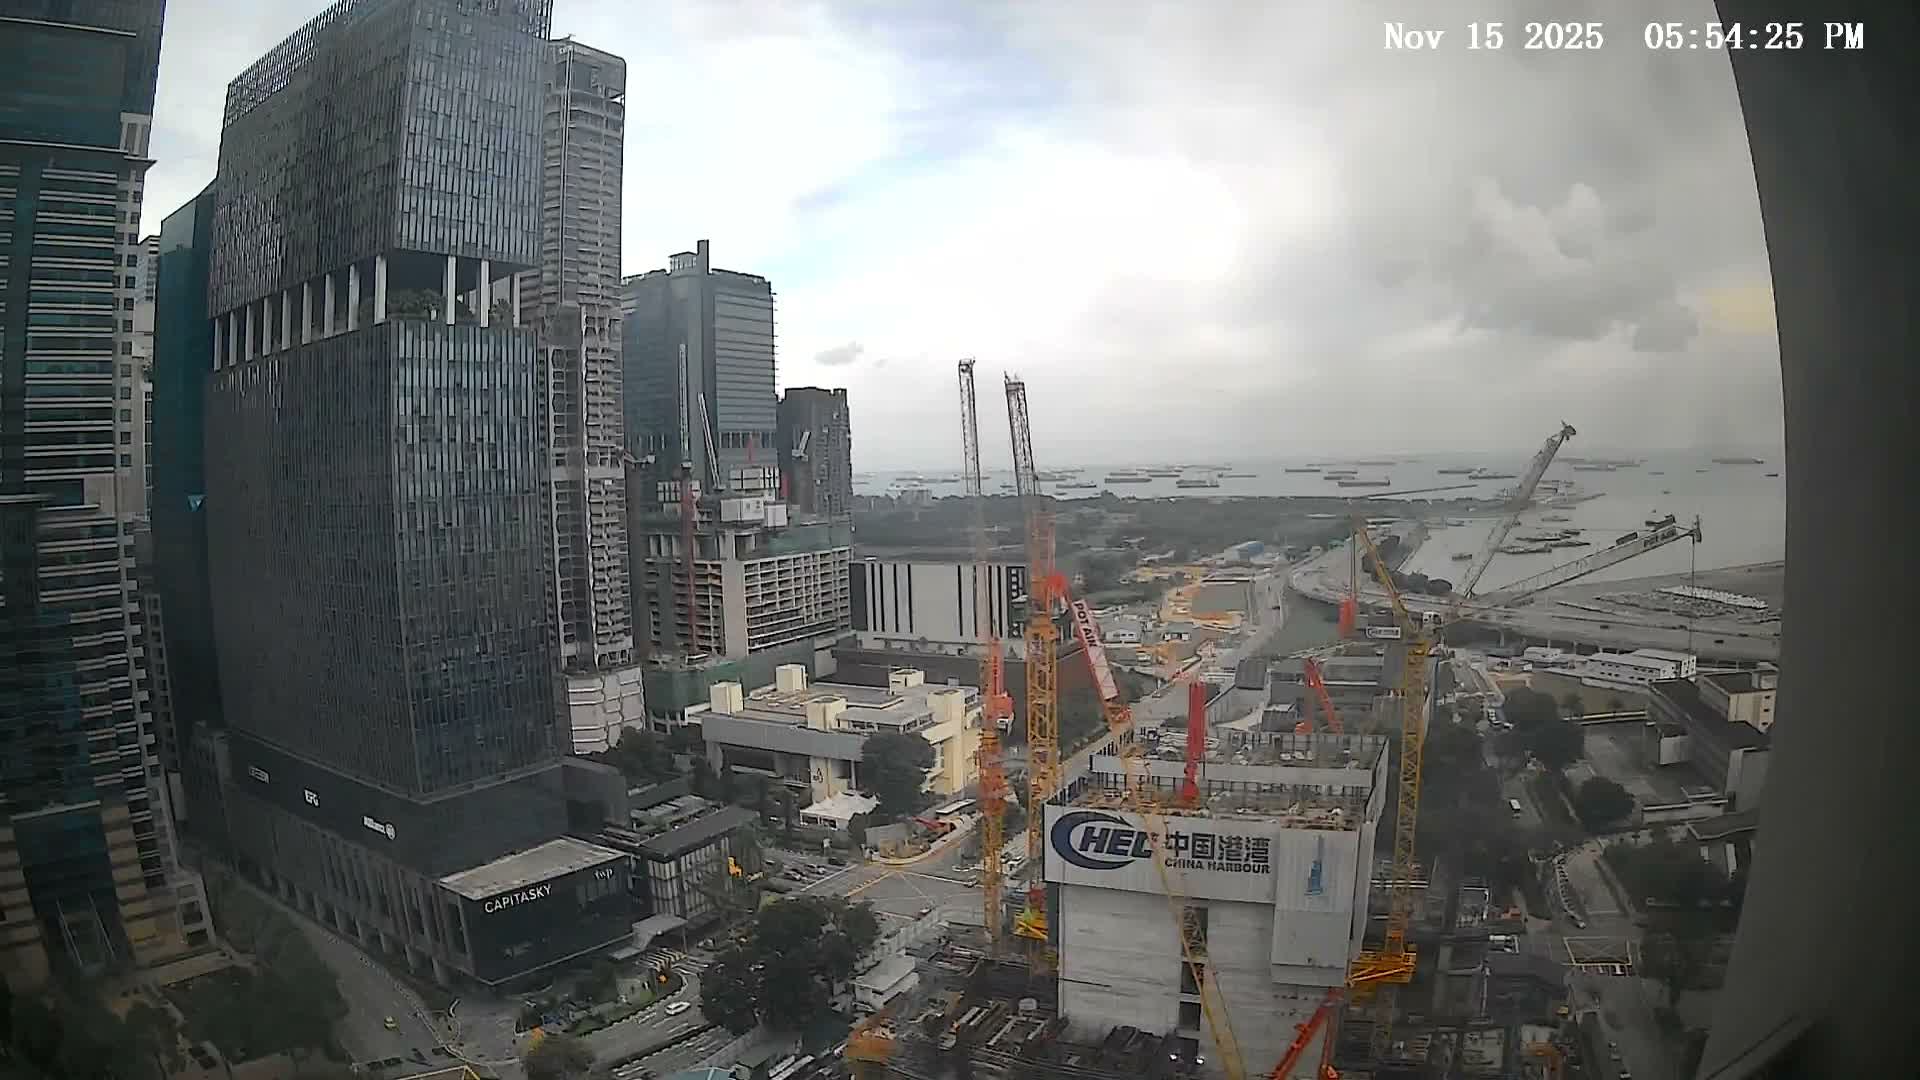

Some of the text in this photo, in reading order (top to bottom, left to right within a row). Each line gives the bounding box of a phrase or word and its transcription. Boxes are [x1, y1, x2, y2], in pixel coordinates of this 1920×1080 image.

[1165, 831, 1271, 864] 中国港湾
[1165, 858, 1271, 875] CHINA HARBOUR
[484, 883, 552, 914] CAPITASKY
